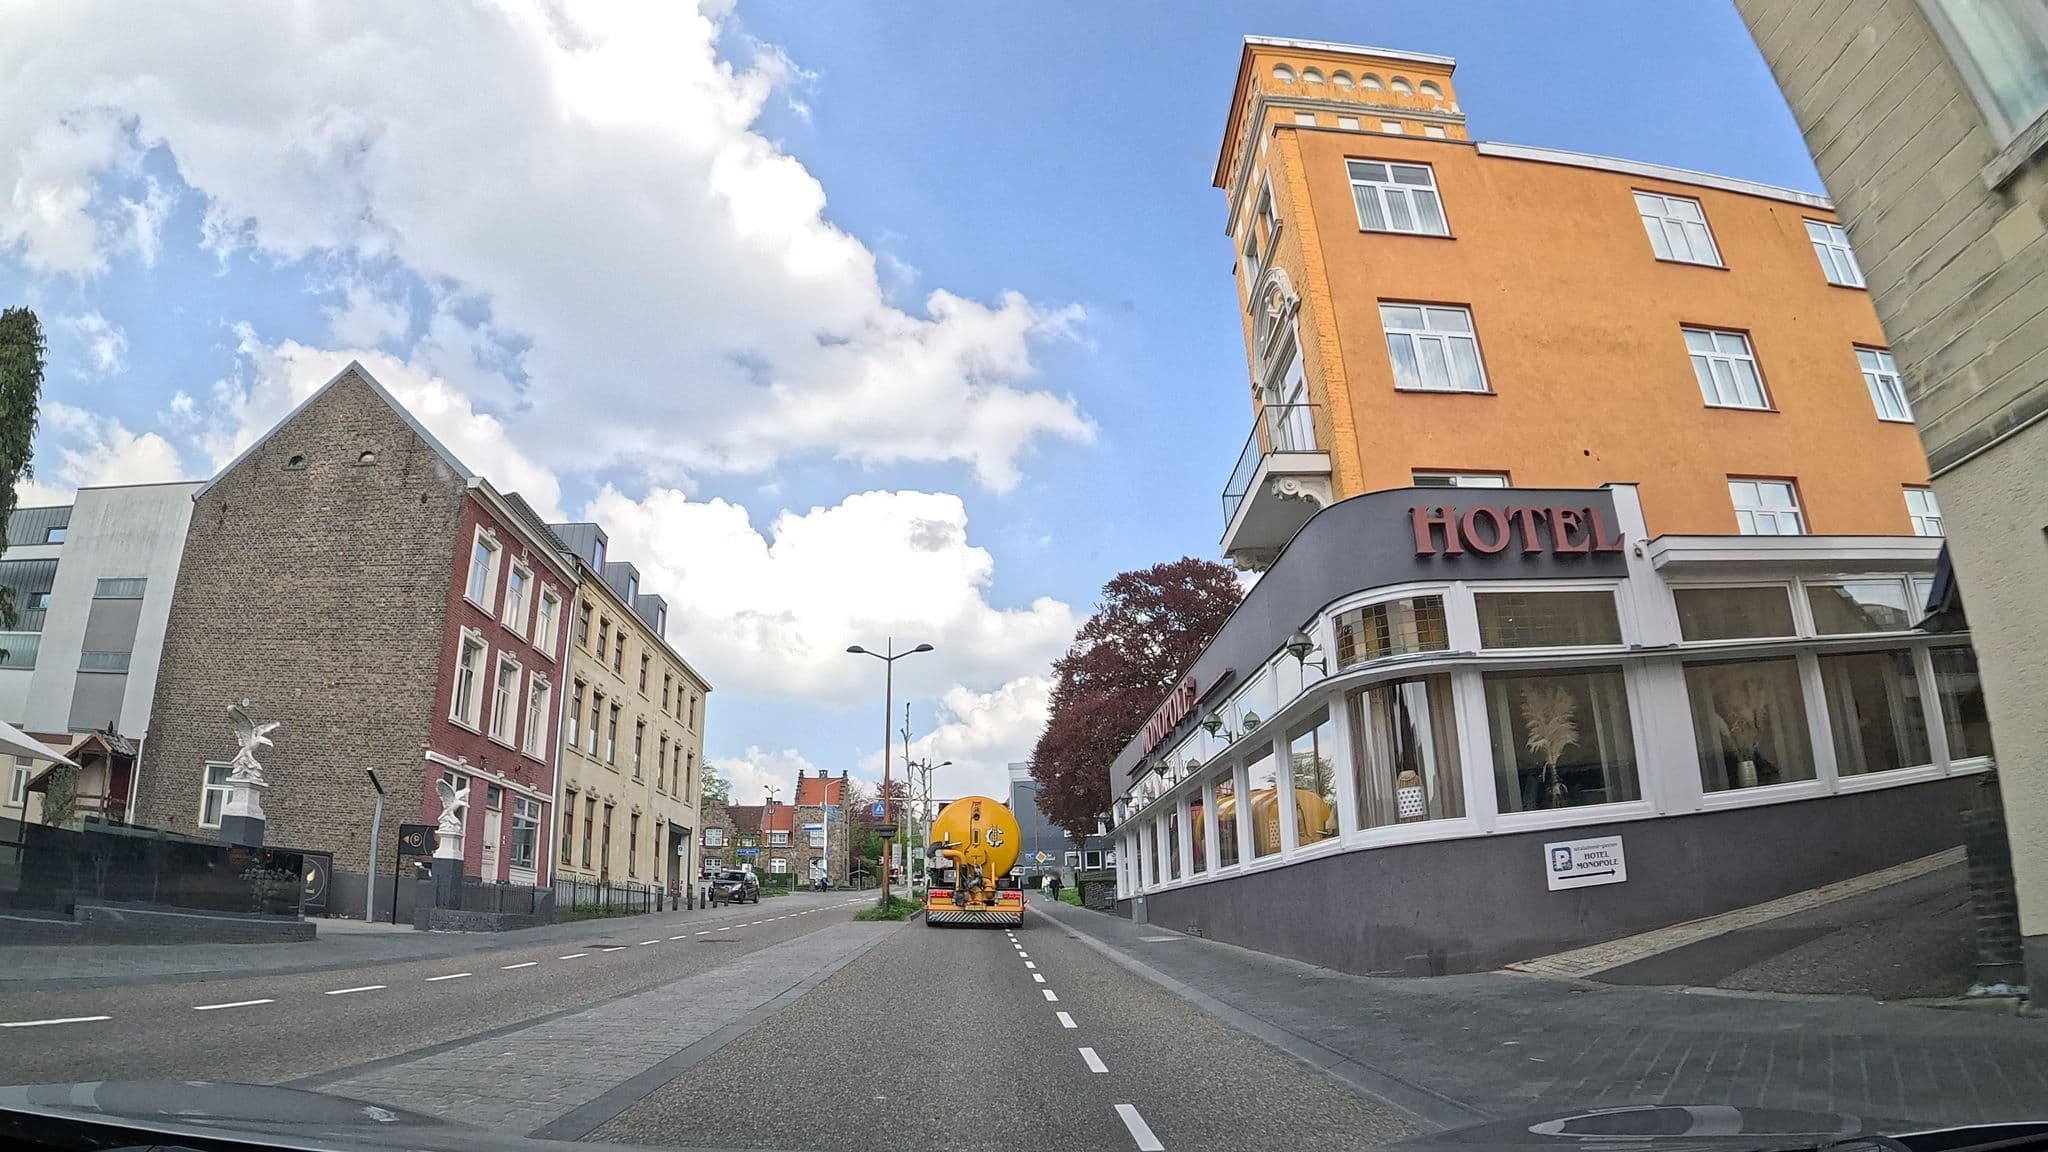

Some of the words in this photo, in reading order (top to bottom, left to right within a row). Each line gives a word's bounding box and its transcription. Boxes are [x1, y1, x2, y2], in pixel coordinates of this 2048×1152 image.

[1409, 504, 1625, 557] HOTEL
[1140, 675, 1196, 759] MONOPOLE
[1576, 858, 1618, 869] MONOPOLE
[1584, 851, 1609, 860] HOTEL
